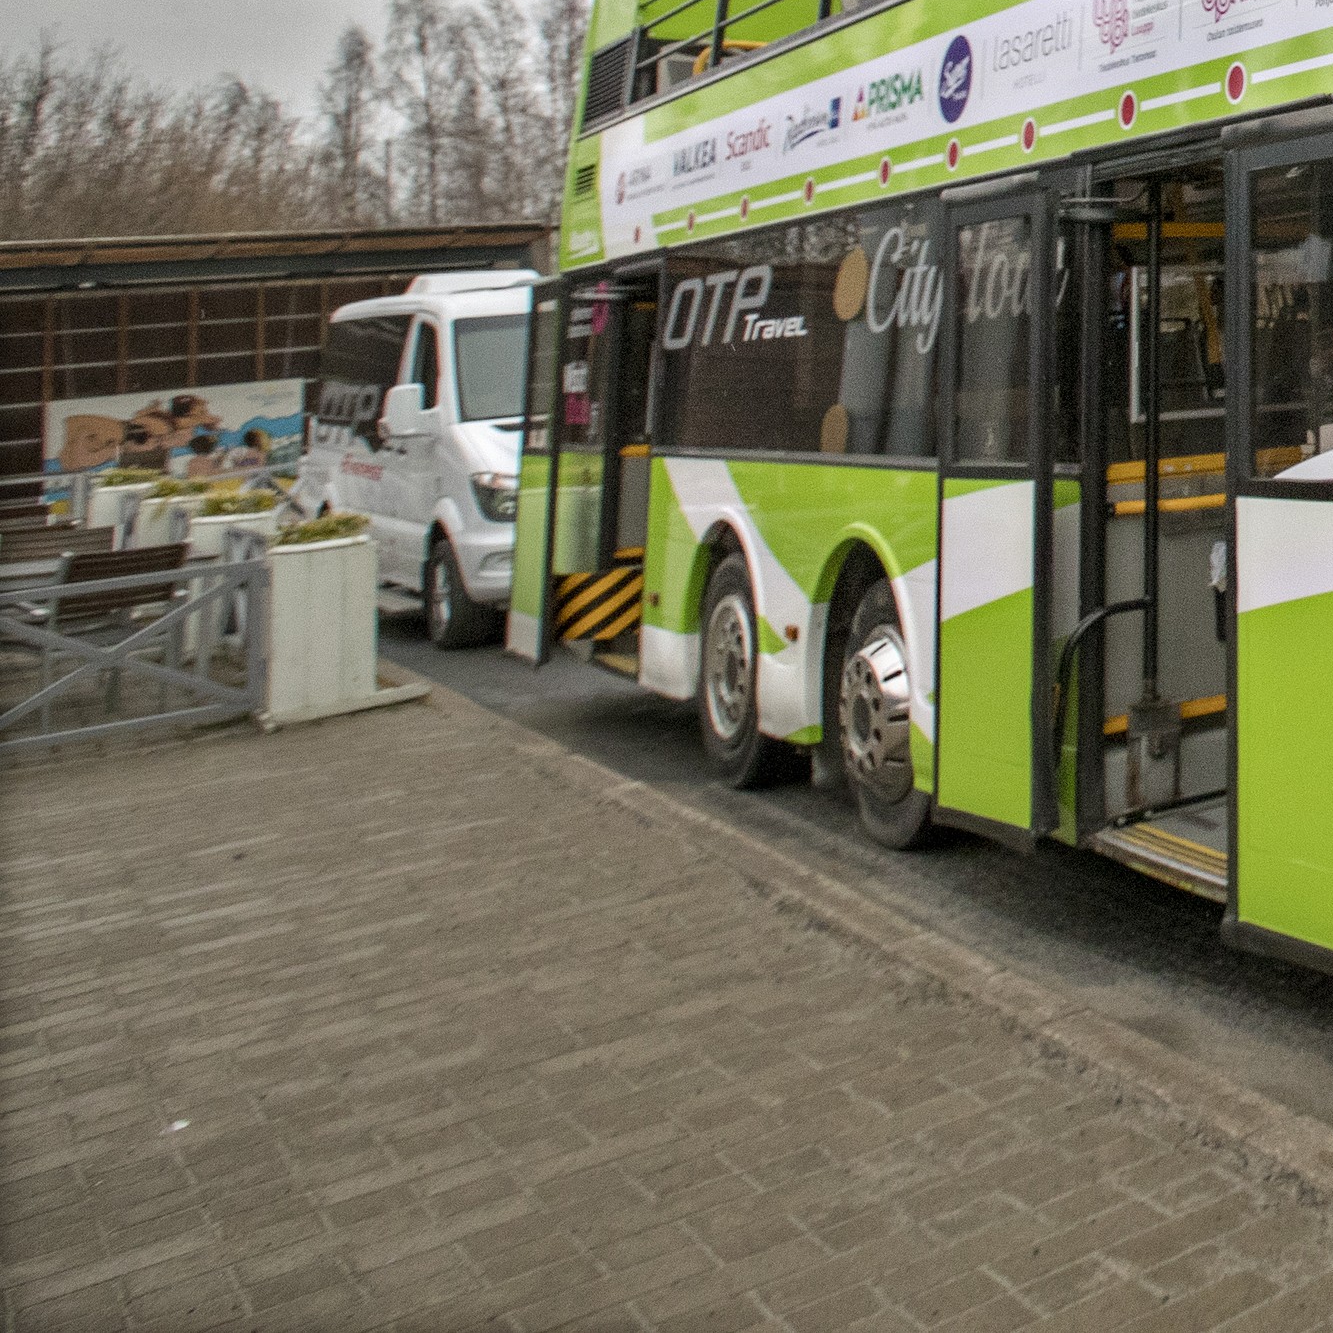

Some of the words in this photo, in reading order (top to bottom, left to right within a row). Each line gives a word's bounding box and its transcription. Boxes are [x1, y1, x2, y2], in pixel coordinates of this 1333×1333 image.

[992, 10, 1075, 72] lasaretti
[868, 67, 925, 114] PRISMA
[725, 118, 772, 161] Scandic
[663, 265, 773, 351] OTP
